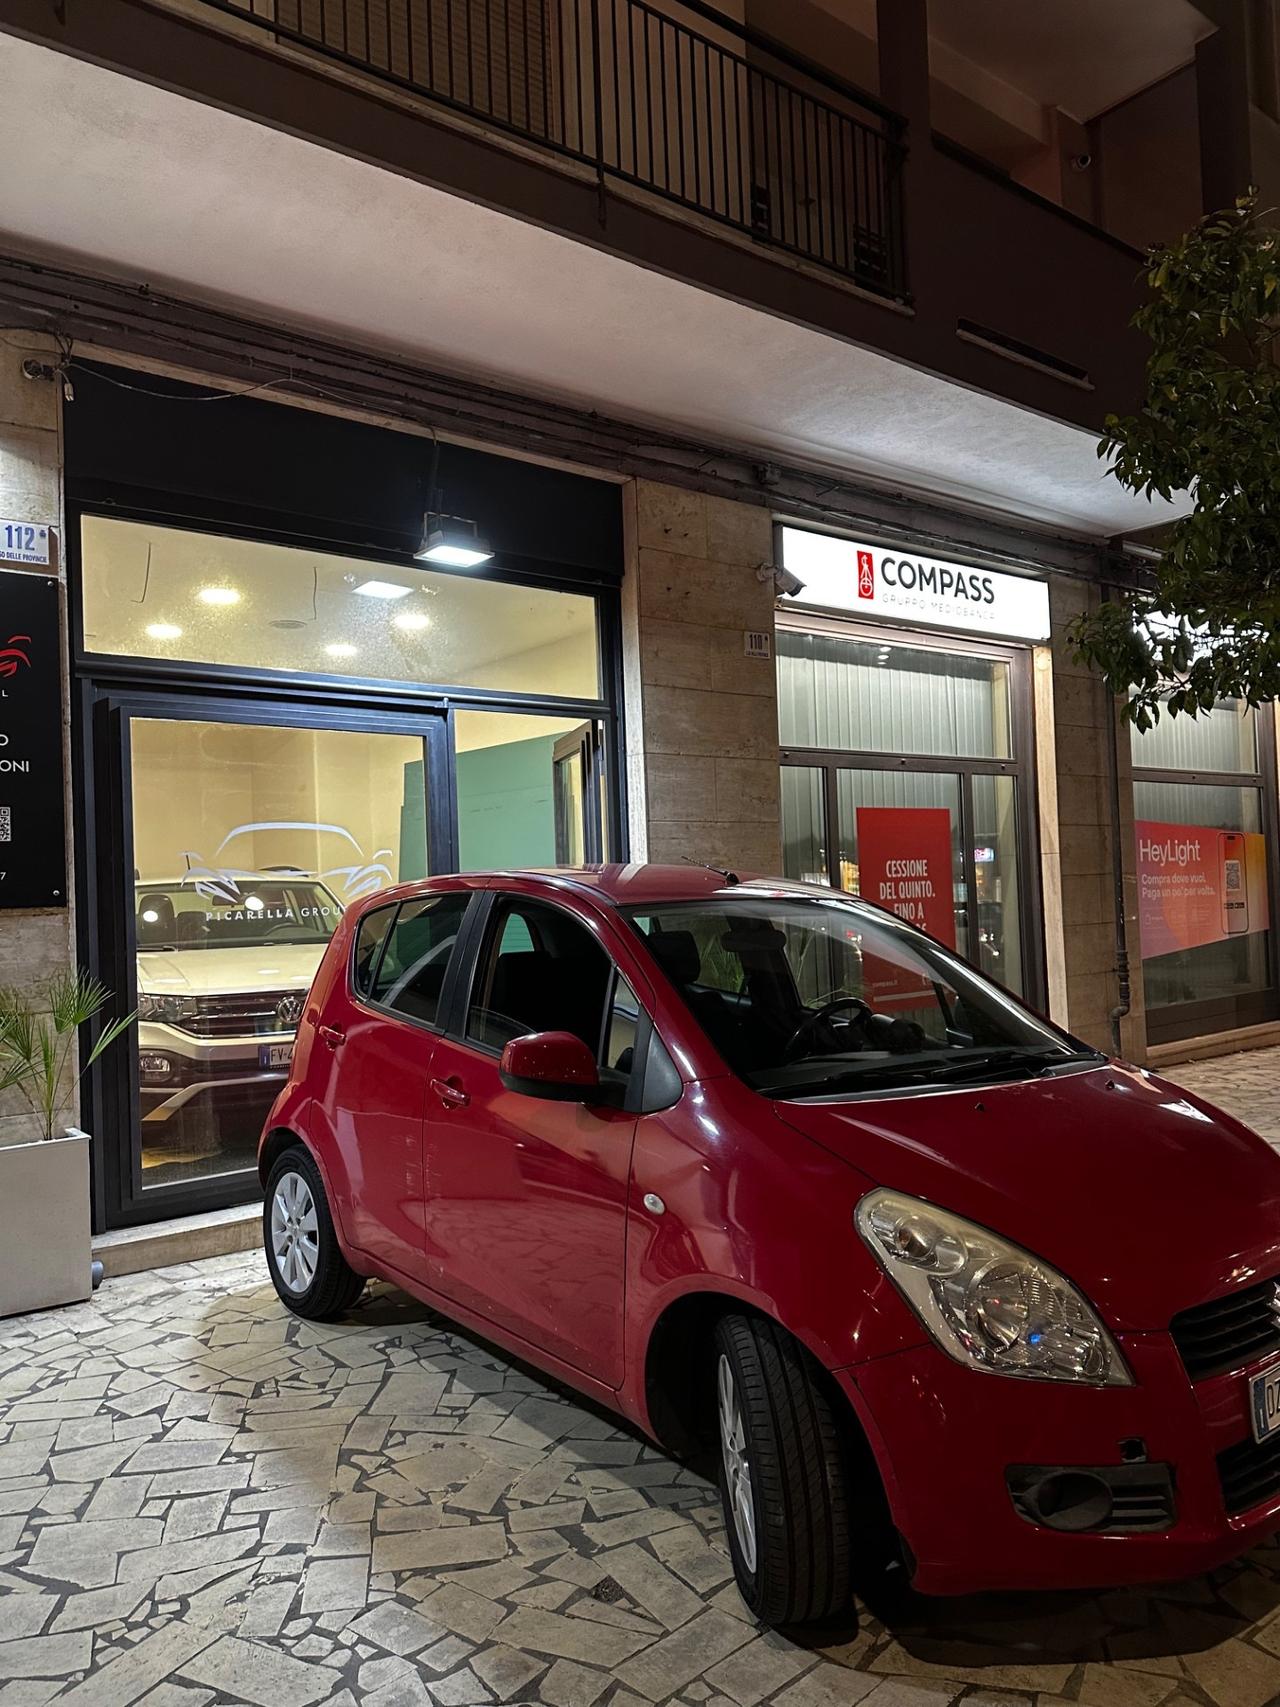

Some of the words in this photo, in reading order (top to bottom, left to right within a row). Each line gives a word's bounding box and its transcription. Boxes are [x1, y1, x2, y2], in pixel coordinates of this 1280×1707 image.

[5, 525, 35, 550] 112
[6, 552, 21, 560] DELLE
[881, 556, 995, 604] COMPASS
[882, 593, 925, 609] GRUPPO
[1139, 839, 1200, 866] HeyLight
[886, 859, 928, 878] CESSIONE
[1142, 873, 1171, 887] Compra
[1172, 872, 1189, 883] dove
[879, 882, 897, 900] DEL
[899, 881, 936, 899] QUINTO.
[1142, 887, 1161, 901] Paga
[206, 908, 294, 921] PICARELLA
[301, 906, 341, 917] GROU
[894, 903, 915, 920] FINO
[917, 902, 924, 919] A
